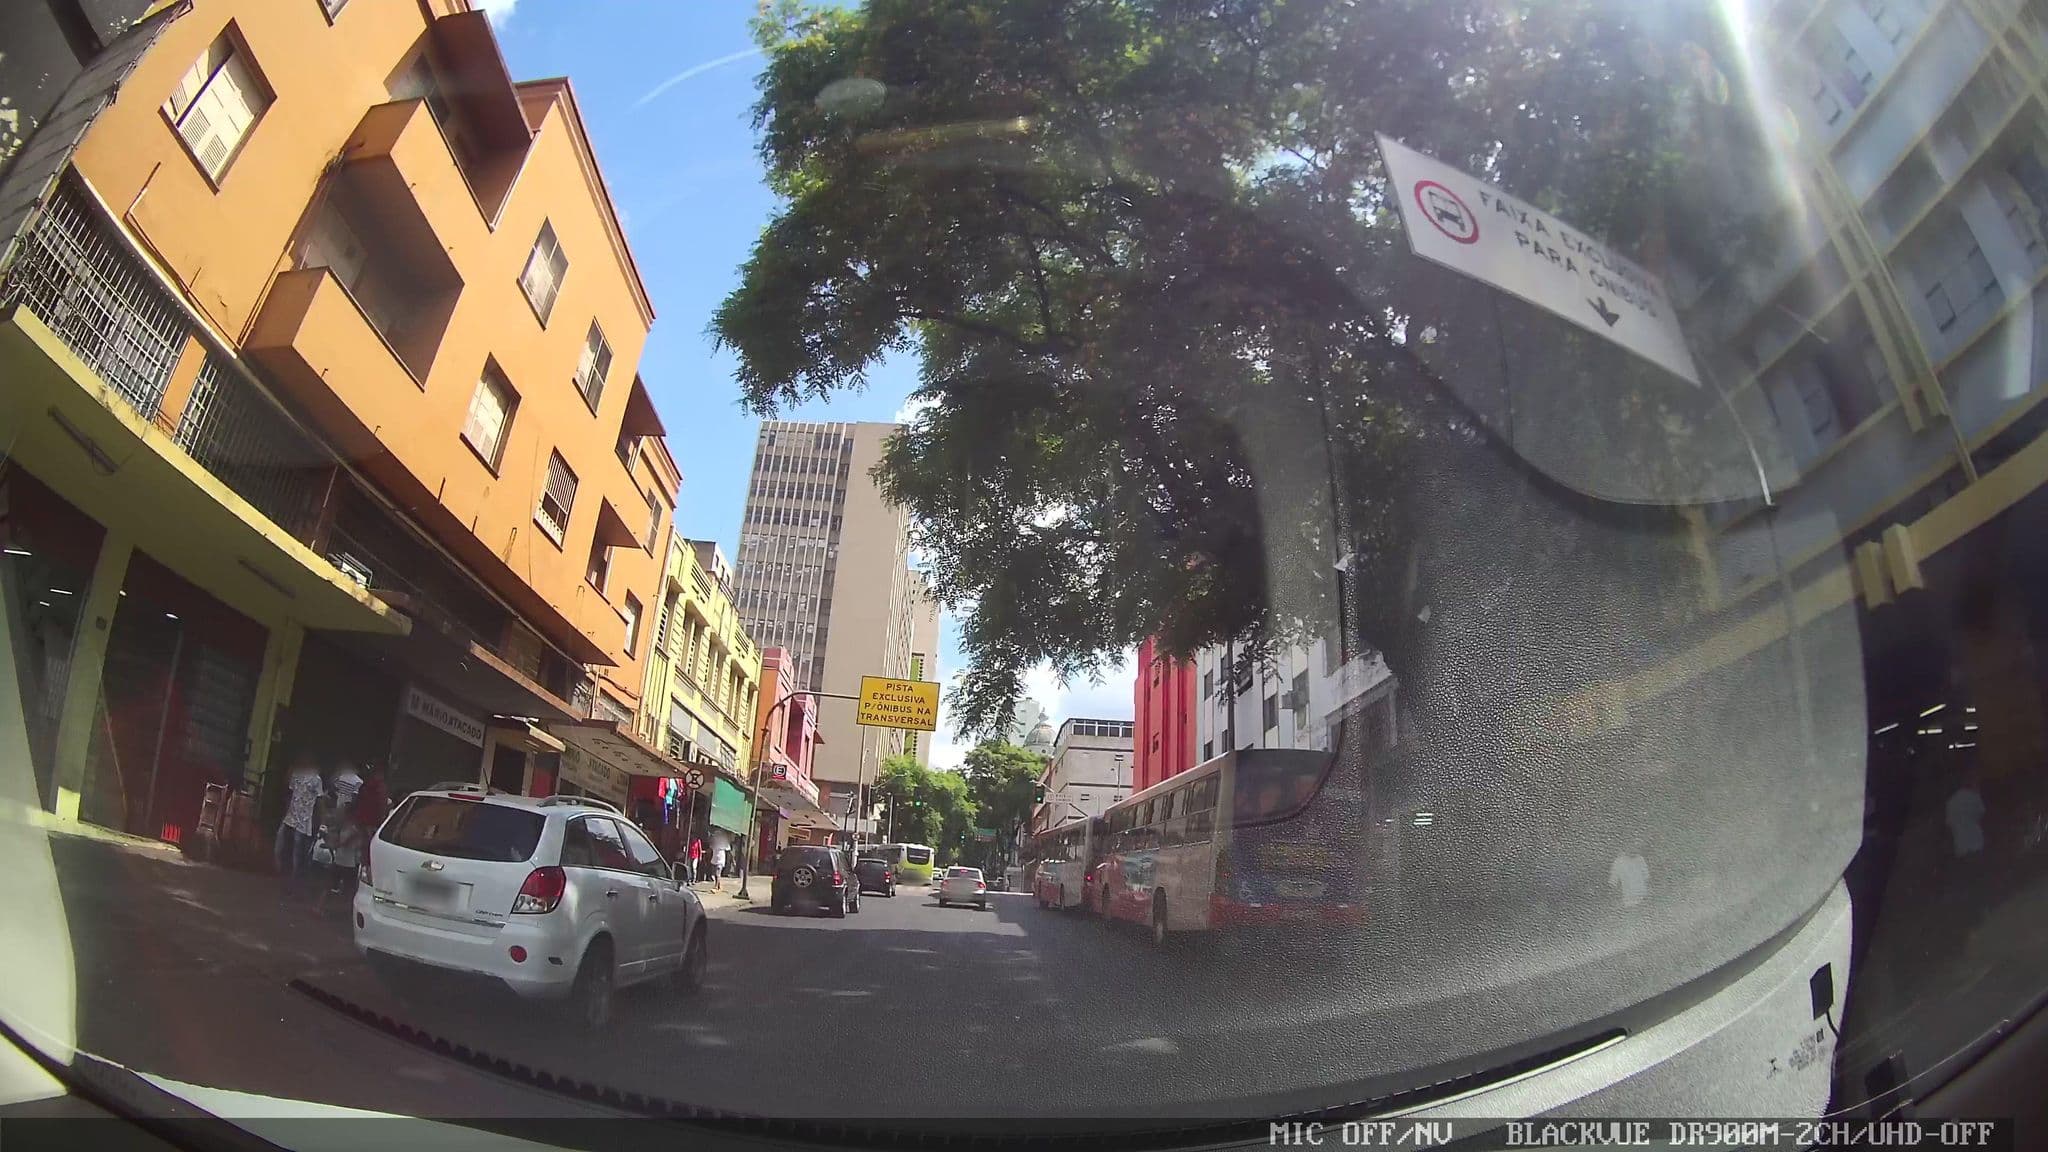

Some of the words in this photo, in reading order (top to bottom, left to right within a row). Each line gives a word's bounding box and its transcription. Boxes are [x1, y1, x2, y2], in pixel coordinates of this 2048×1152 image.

[1479, 189, 1550, 238] FAIXA
[1560, 231, 1663, 300] EXCLU
[1514, 231, 1579, 273] PARA
[886, 683, 914, 692] PISTA
[872, 692, 926, 704] EXCLUSIVA
[917, 707, 931, 715] NA
[860, 712, 933, 726] TRANSVERSAL
